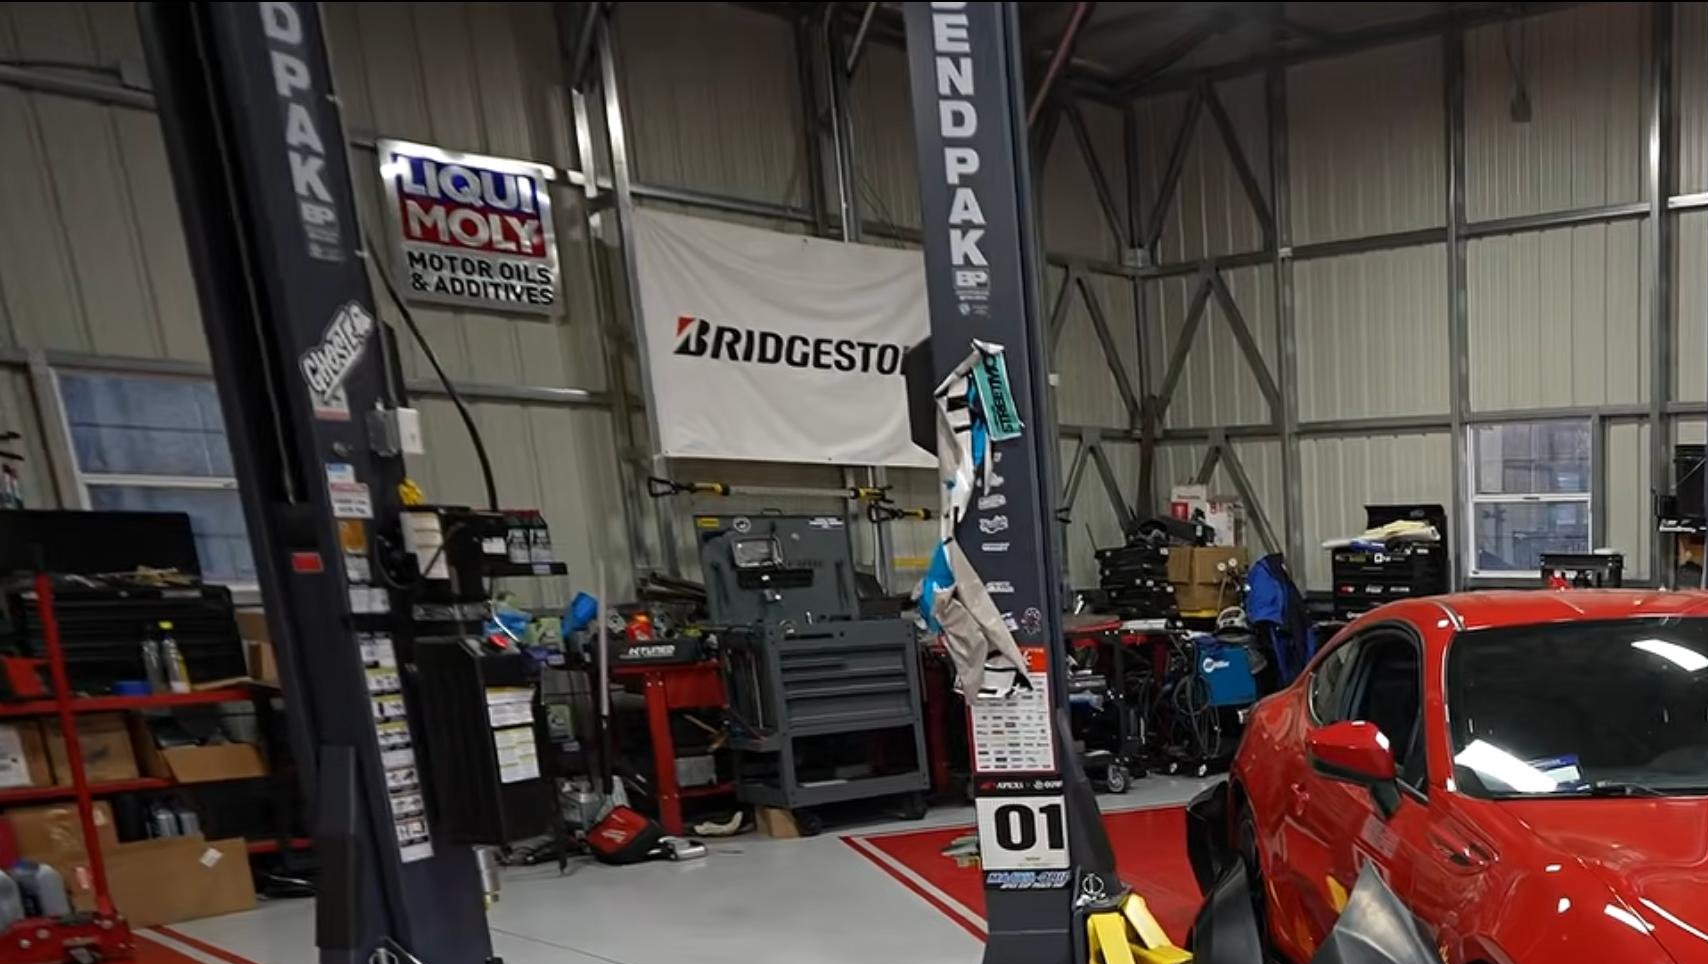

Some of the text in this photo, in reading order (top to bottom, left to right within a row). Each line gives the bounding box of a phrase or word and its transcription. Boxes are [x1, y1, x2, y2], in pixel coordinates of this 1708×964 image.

[930, 2, 989, 266] ENDPAK
[399, 155, 536, 214] LIQUI
[405, 200, 541, 254] MOLY
[407, 251, 553, 285] MOTOR OILS
[411, 272, 554, 305] & ADDITIVES
[674, 317, 908, 375] BRIDGESTO
[994, 804, 1064, 851] 01
